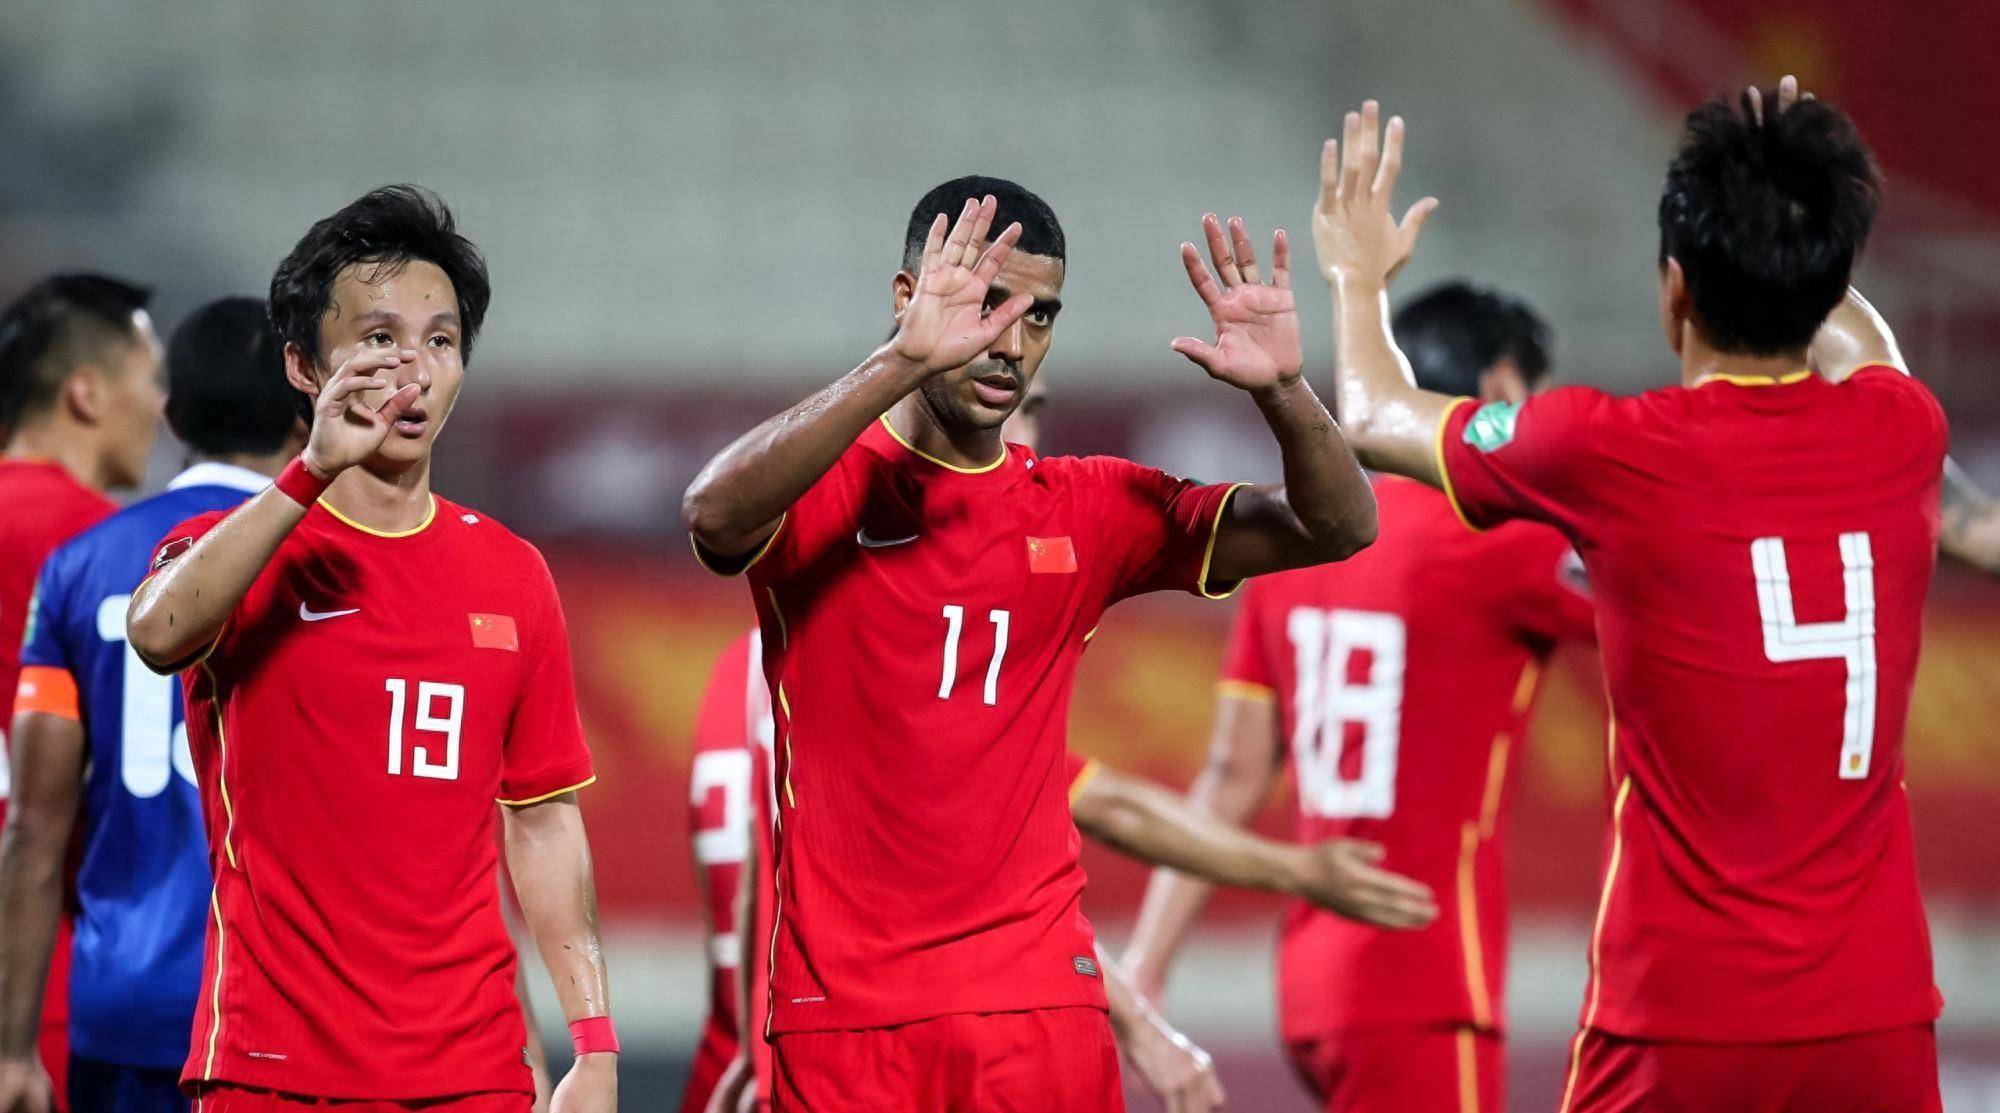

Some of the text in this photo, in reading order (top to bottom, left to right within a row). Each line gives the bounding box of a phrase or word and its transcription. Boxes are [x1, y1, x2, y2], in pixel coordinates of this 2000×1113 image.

[385, 678, 464, 780] 19
[938, 604, 1010, 706] 11
[1287, 606, 1407, 820] 18
[1750, 531, 1877, 780] 4
